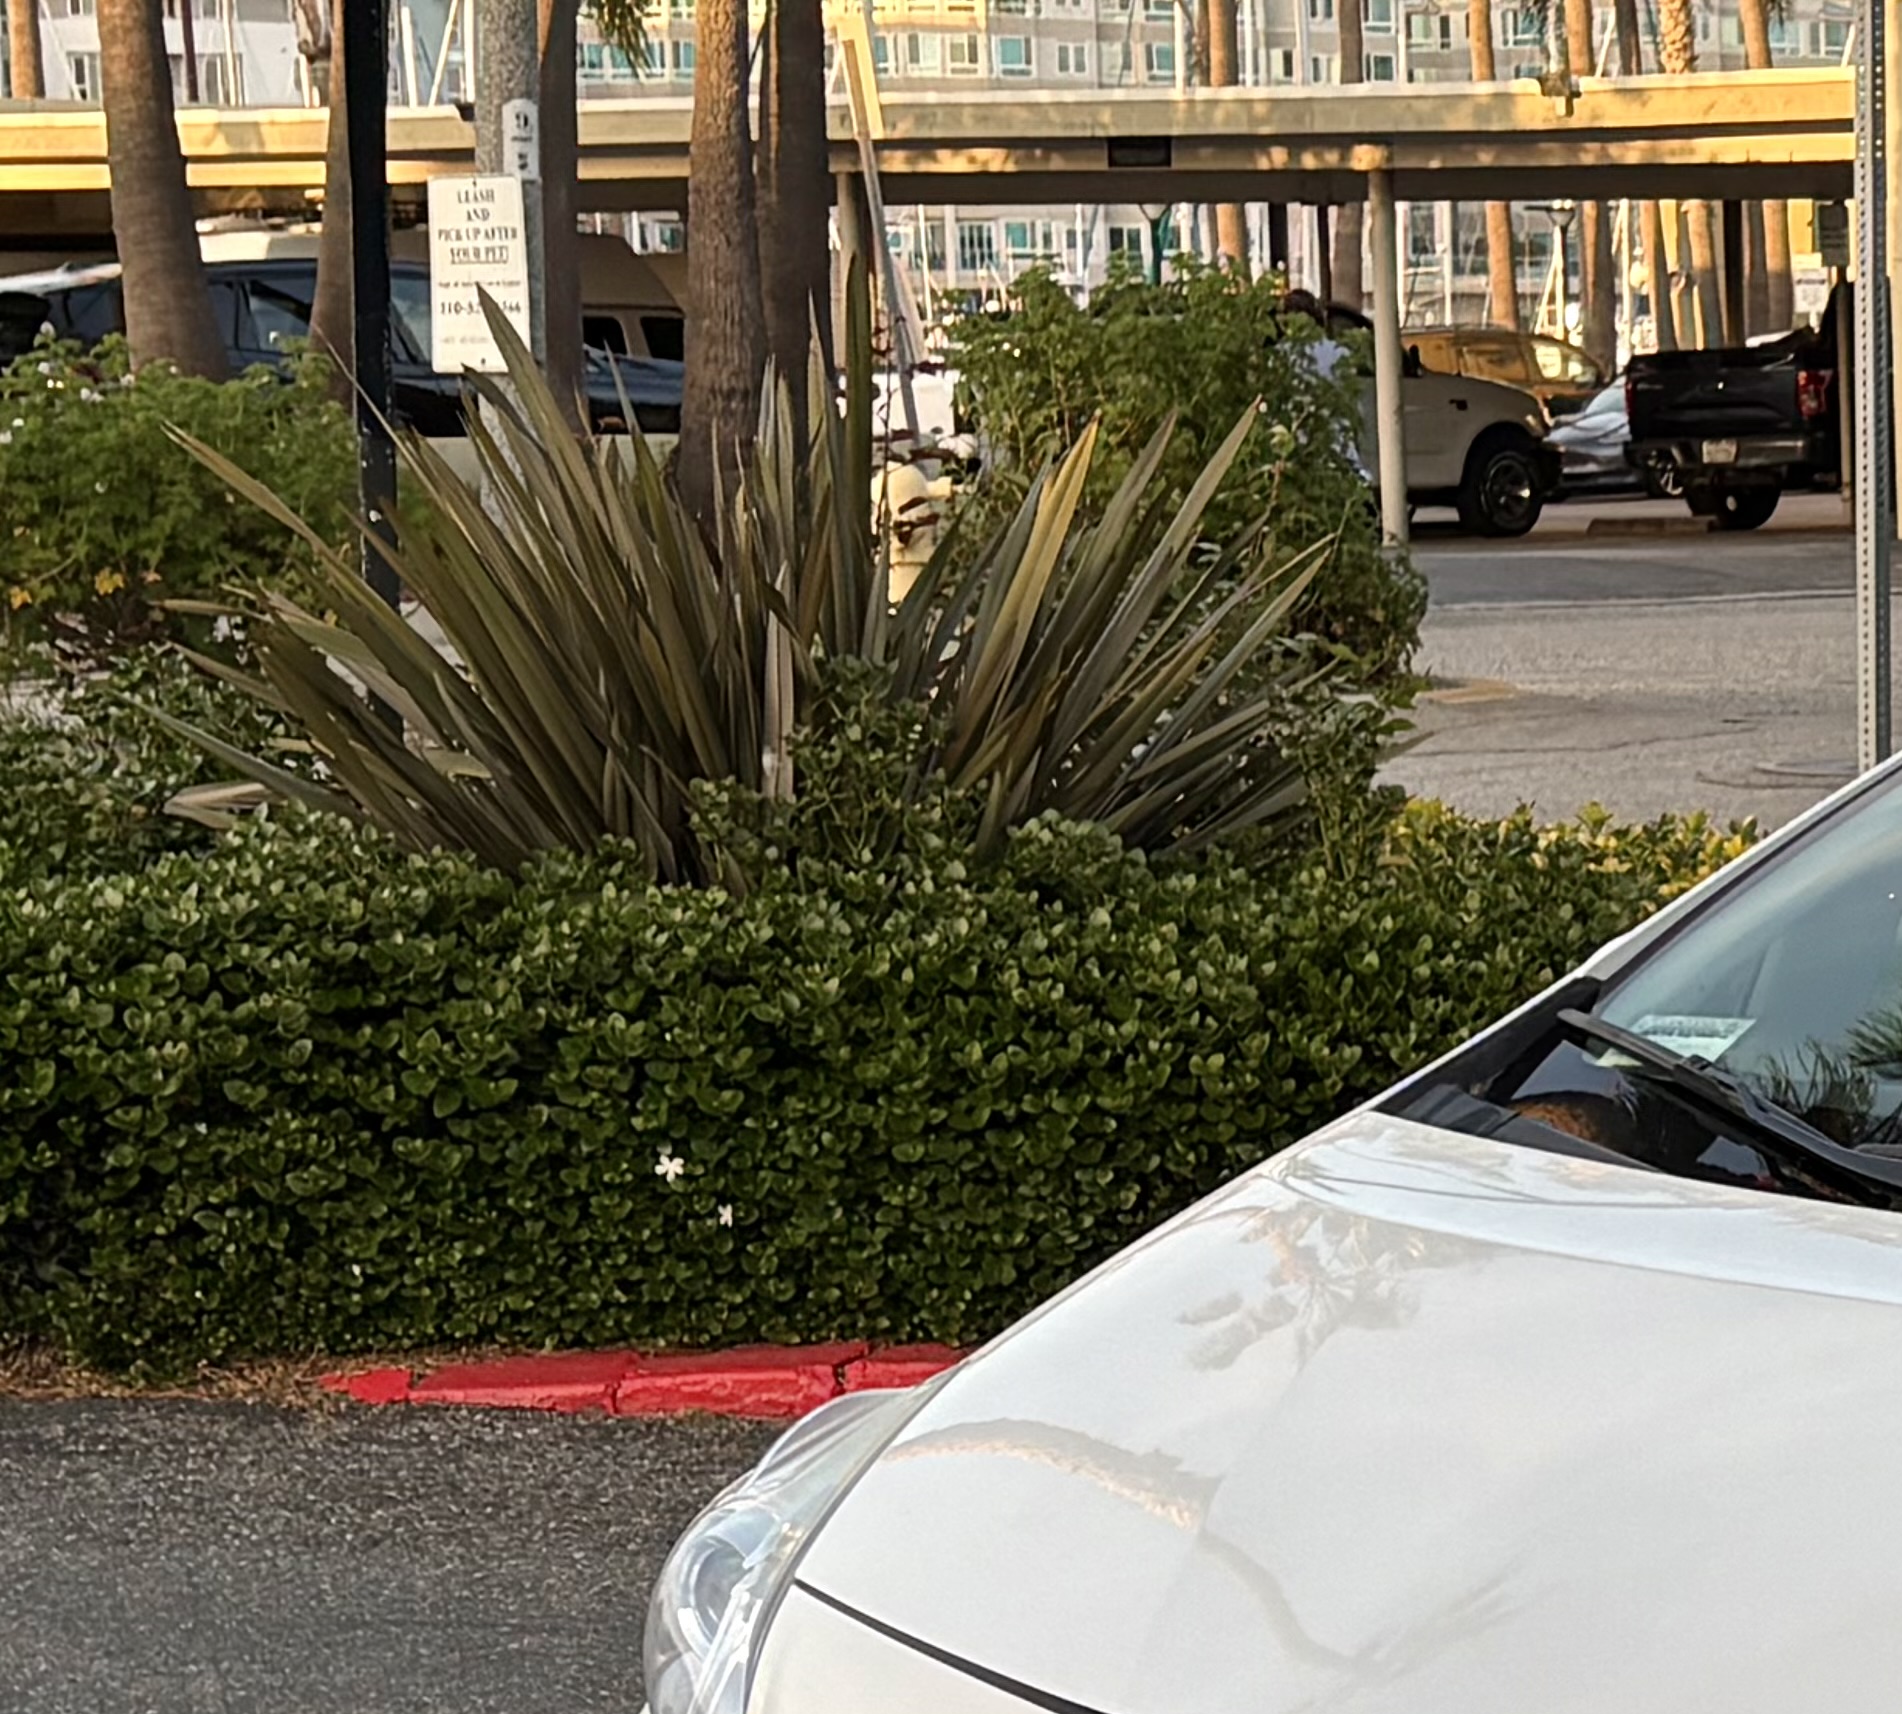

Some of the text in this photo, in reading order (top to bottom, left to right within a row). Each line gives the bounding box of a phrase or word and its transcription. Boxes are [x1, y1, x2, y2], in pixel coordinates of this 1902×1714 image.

[457, 189, 495, 204] LEASH
[466, 207, 490, 222] AND
[438, 226, 518, 243] PICK UP AFTER
